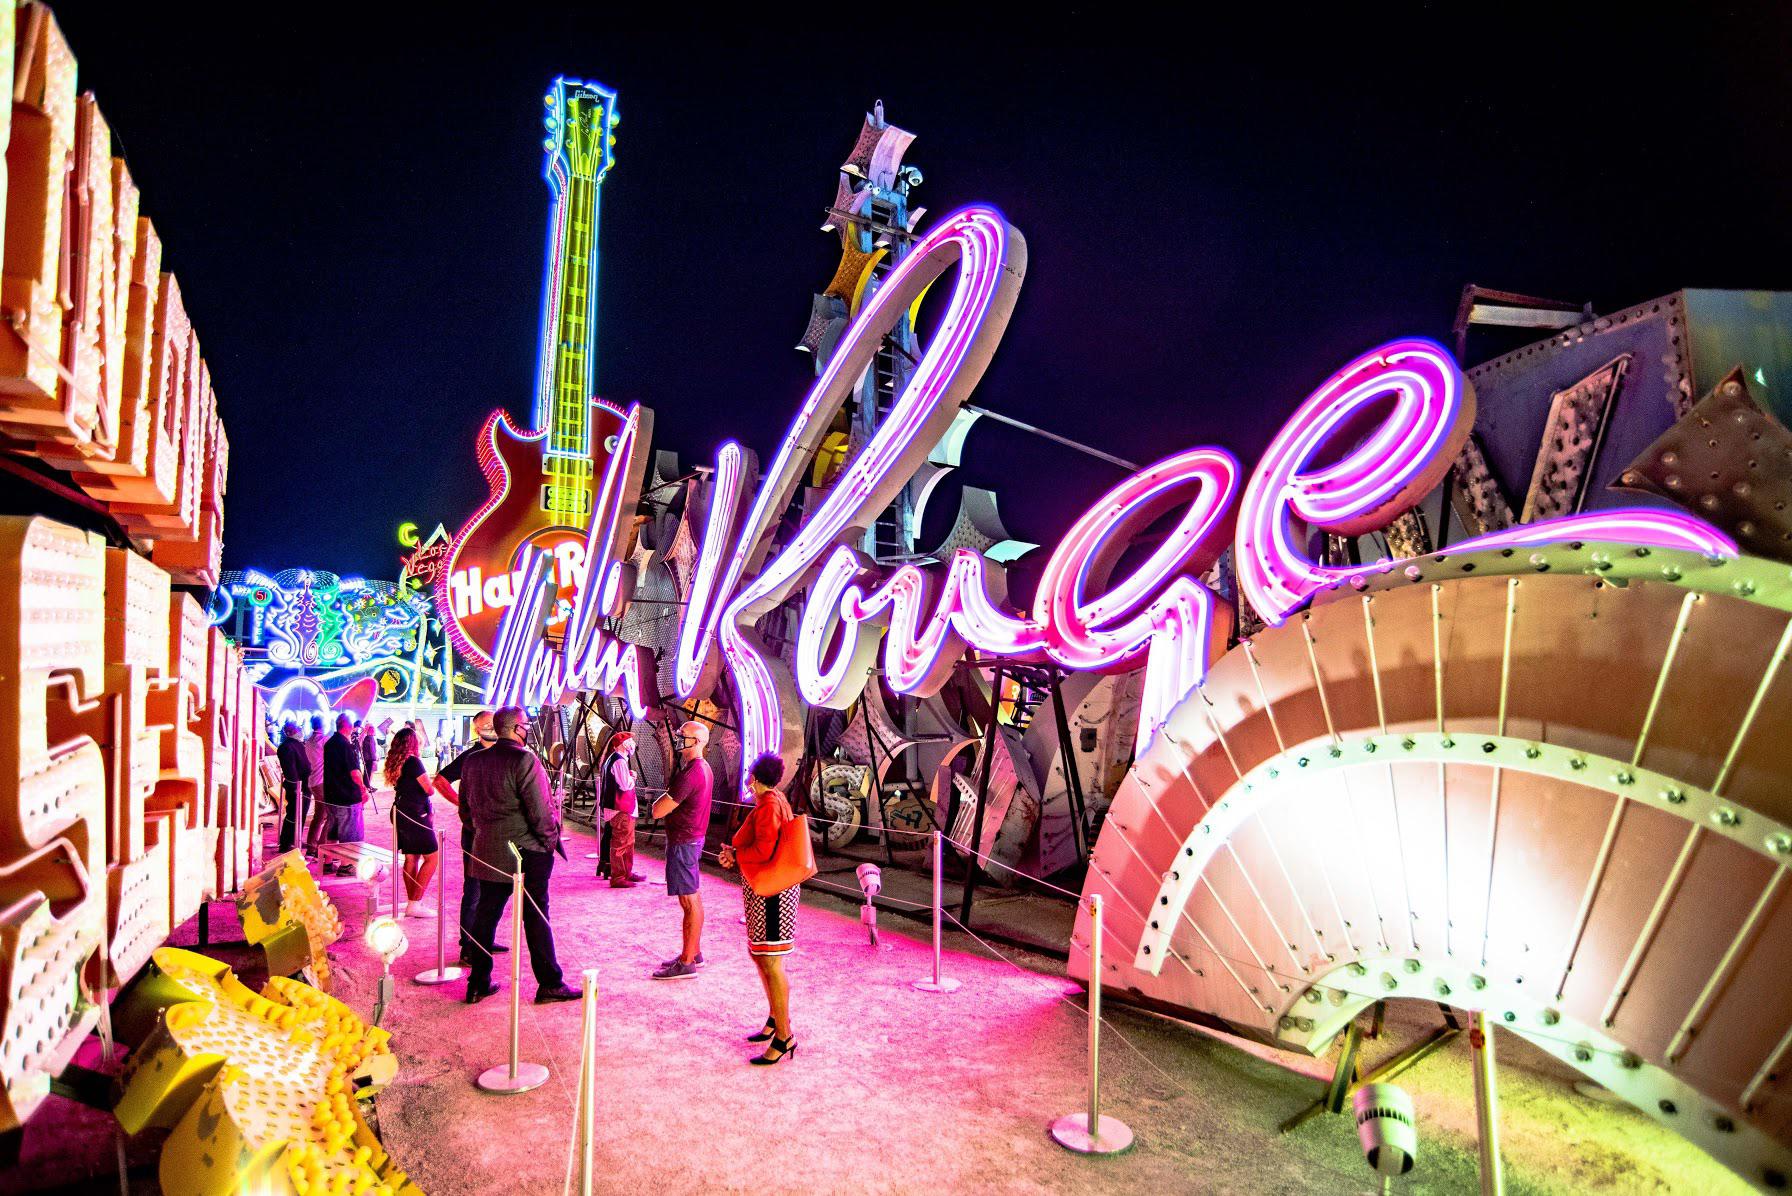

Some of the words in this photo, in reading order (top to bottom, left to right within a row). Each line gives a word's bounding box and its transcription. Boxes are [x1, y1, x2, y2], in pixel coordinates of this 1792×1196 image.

[574, 90, 600, 103] Gibson
[0, 0, 229, 592] INION'S
[676, 204, 1738, 802] Rouge
[401, 554, 444, 584] Vega
[256, 590, 267, 601] 51
[254, 606, 264, 644] MOTEL
